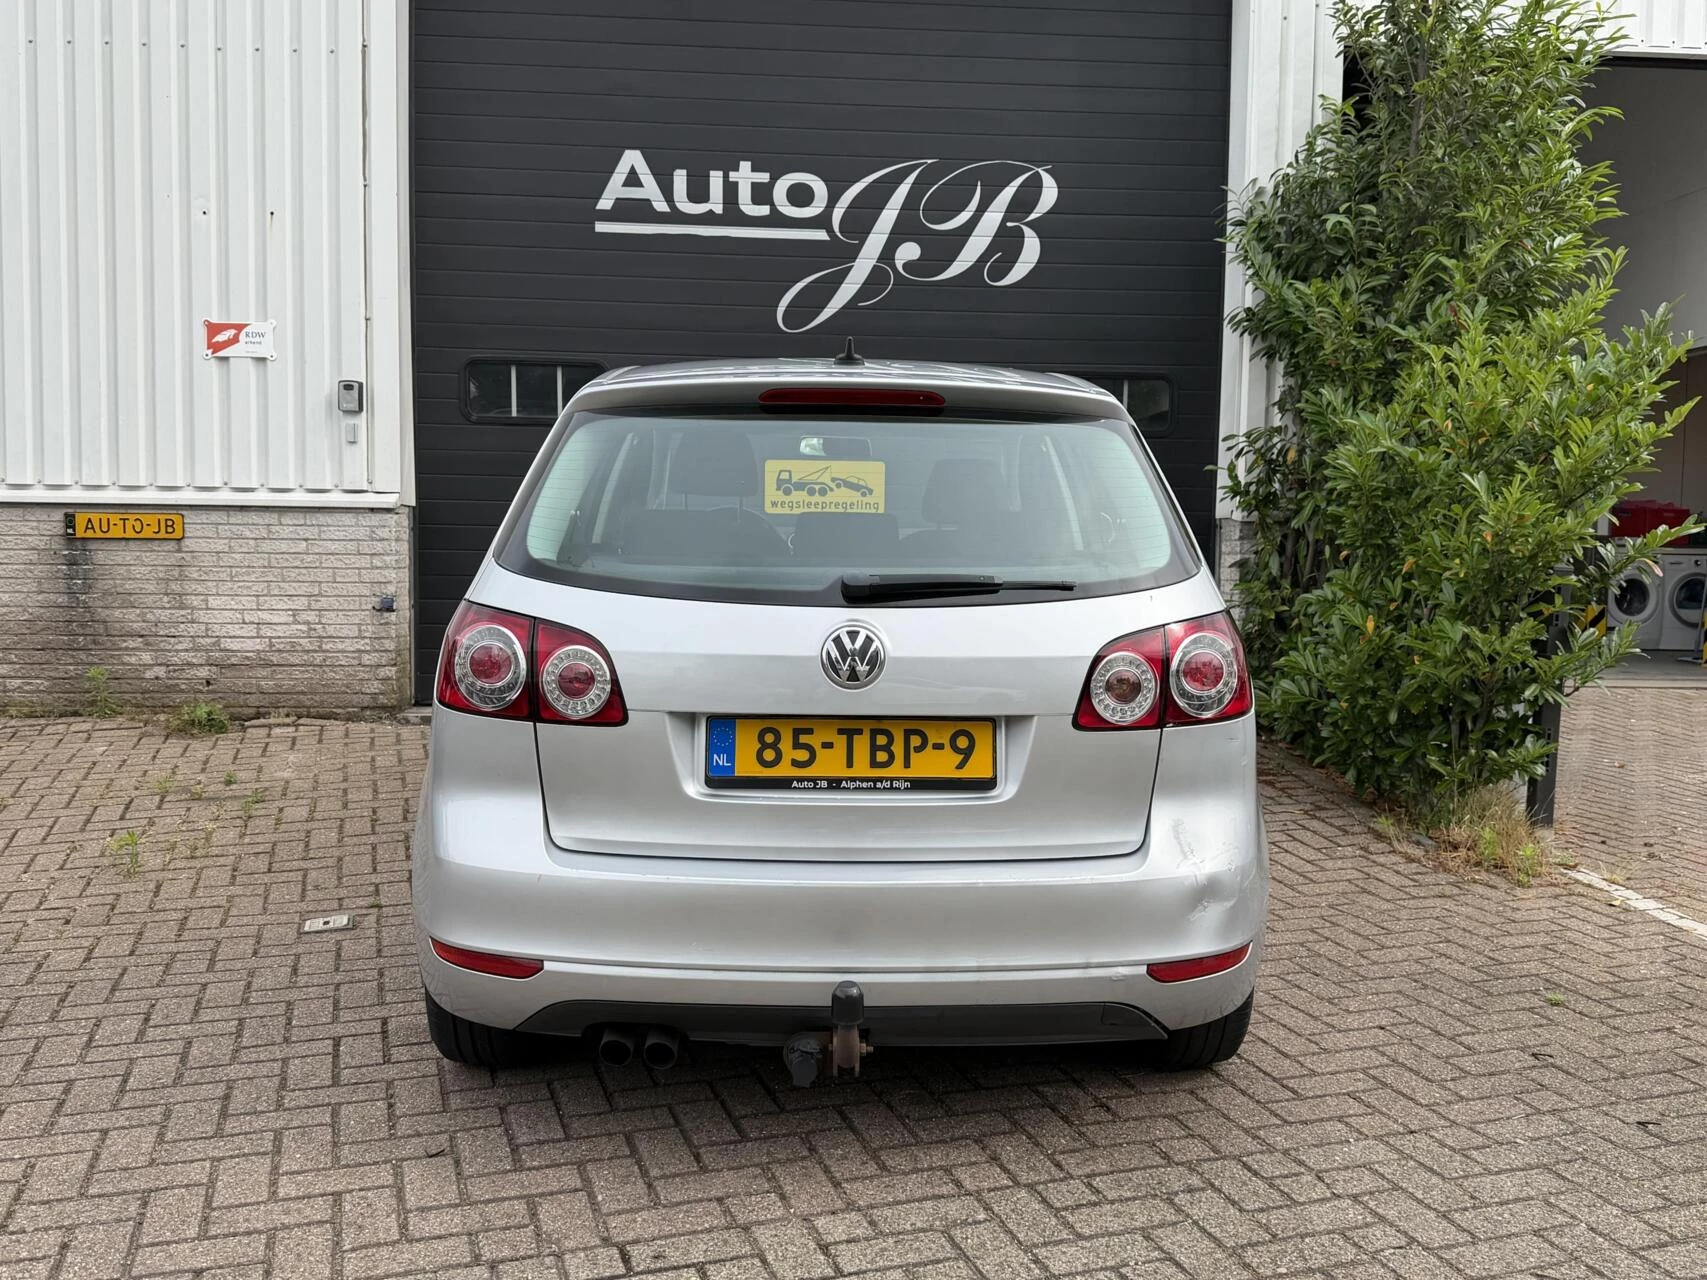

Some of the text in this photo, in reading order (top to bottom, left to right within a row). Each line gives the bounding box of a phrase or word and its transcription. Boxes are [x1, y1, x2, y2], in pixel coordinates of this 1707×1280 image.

[595, 149, 1059, 333] Auto JB
[244, 330, 266, 339] RDW
[770, 499, 880, 512] wegsleepregeling
[83, 517, 176, 534] AU-TO-JB
[755, 726, 977, 770] 85-TBP-9
[713, 753, 731, 766] NL
[791, 780, 814, 788] Auto
[816, 780, 828, 788] JB
[840, 780, 874, 789] Alphen
[876, 780, 891, 788] a/d
[893, 780, 911, 789] Rijn
